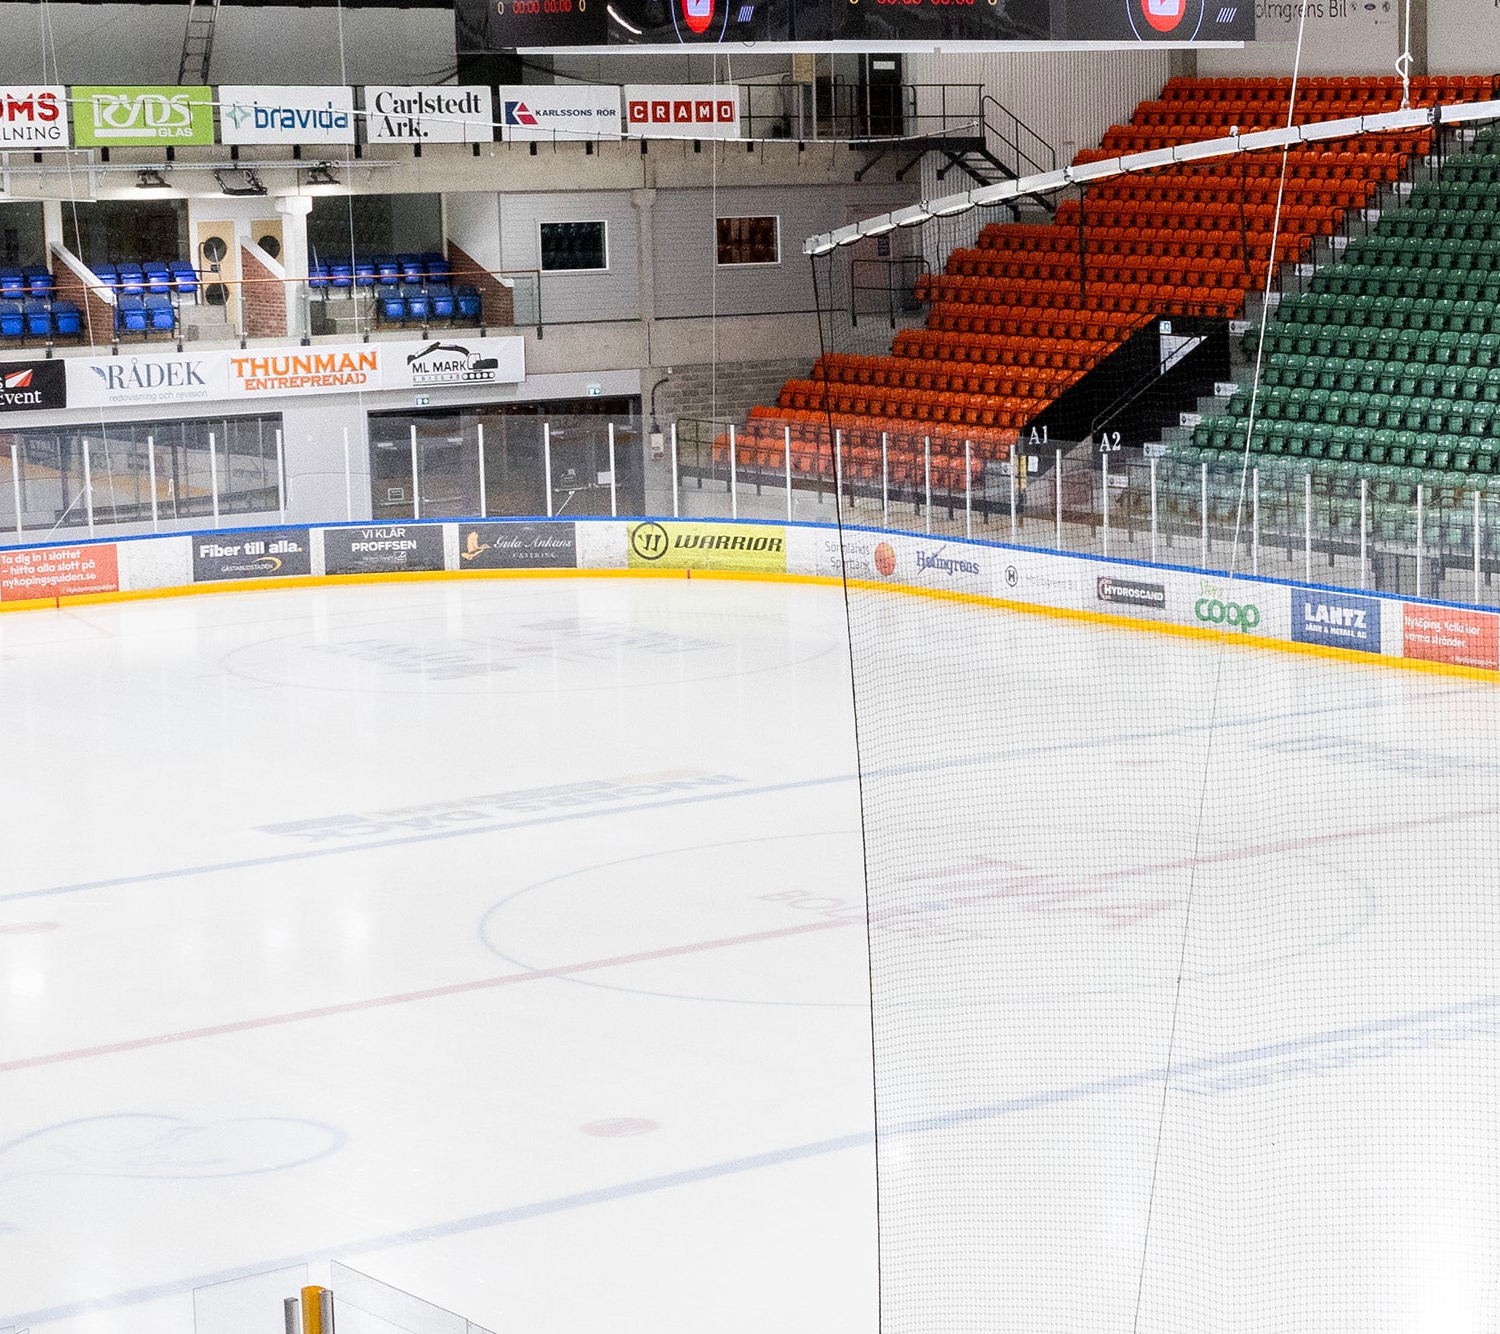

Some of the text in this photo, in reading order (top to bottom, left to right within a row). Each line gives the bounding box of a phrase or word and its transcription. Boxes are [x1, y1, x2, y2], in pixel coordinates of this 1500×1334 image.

[375, 90, 482, 115] Carlstedt
[535, 105, 617, 119] KARLSSONS RÖR
[631, 101, 734, 124] CRAMO
[254, 100, 349, 130] bravida
[157, 127, 194, 138] GLAS
[376, 115, 429, 139] Ark.
[107, 356, 207, 392] RÅDEK
[230, 350, 378, 379] THUNMAN
[411, 359, 468, 375] ML MARK
[243, 372, 367, 392] ENTREPRENAD
[108, 390, 175, 404] redovisning och
[1028, 425, 1049, 446] A1
[1098, 431, 1122, 452] A2
[361, 526, 406, 540] VI KLÄR
[528, 532, 574, 549] Ankans
[673, 534, 784, 552] WARRIOR
[199, 538, 304, 559] Fiber till alla.
[350, 538, 418, 553] PROFFSEN
[0, 549, 81, 565] Ta dig in slottet
[9, 559, 96, 575] hitta alla slott på
[1, 573, 98, 589] nykopingsguiden.se
[1103, 582, 1164, 602] HYDROSCAND
[1193, 597, 1261, 635] coop
[1304, 602, 1367, 629] LANTZ
